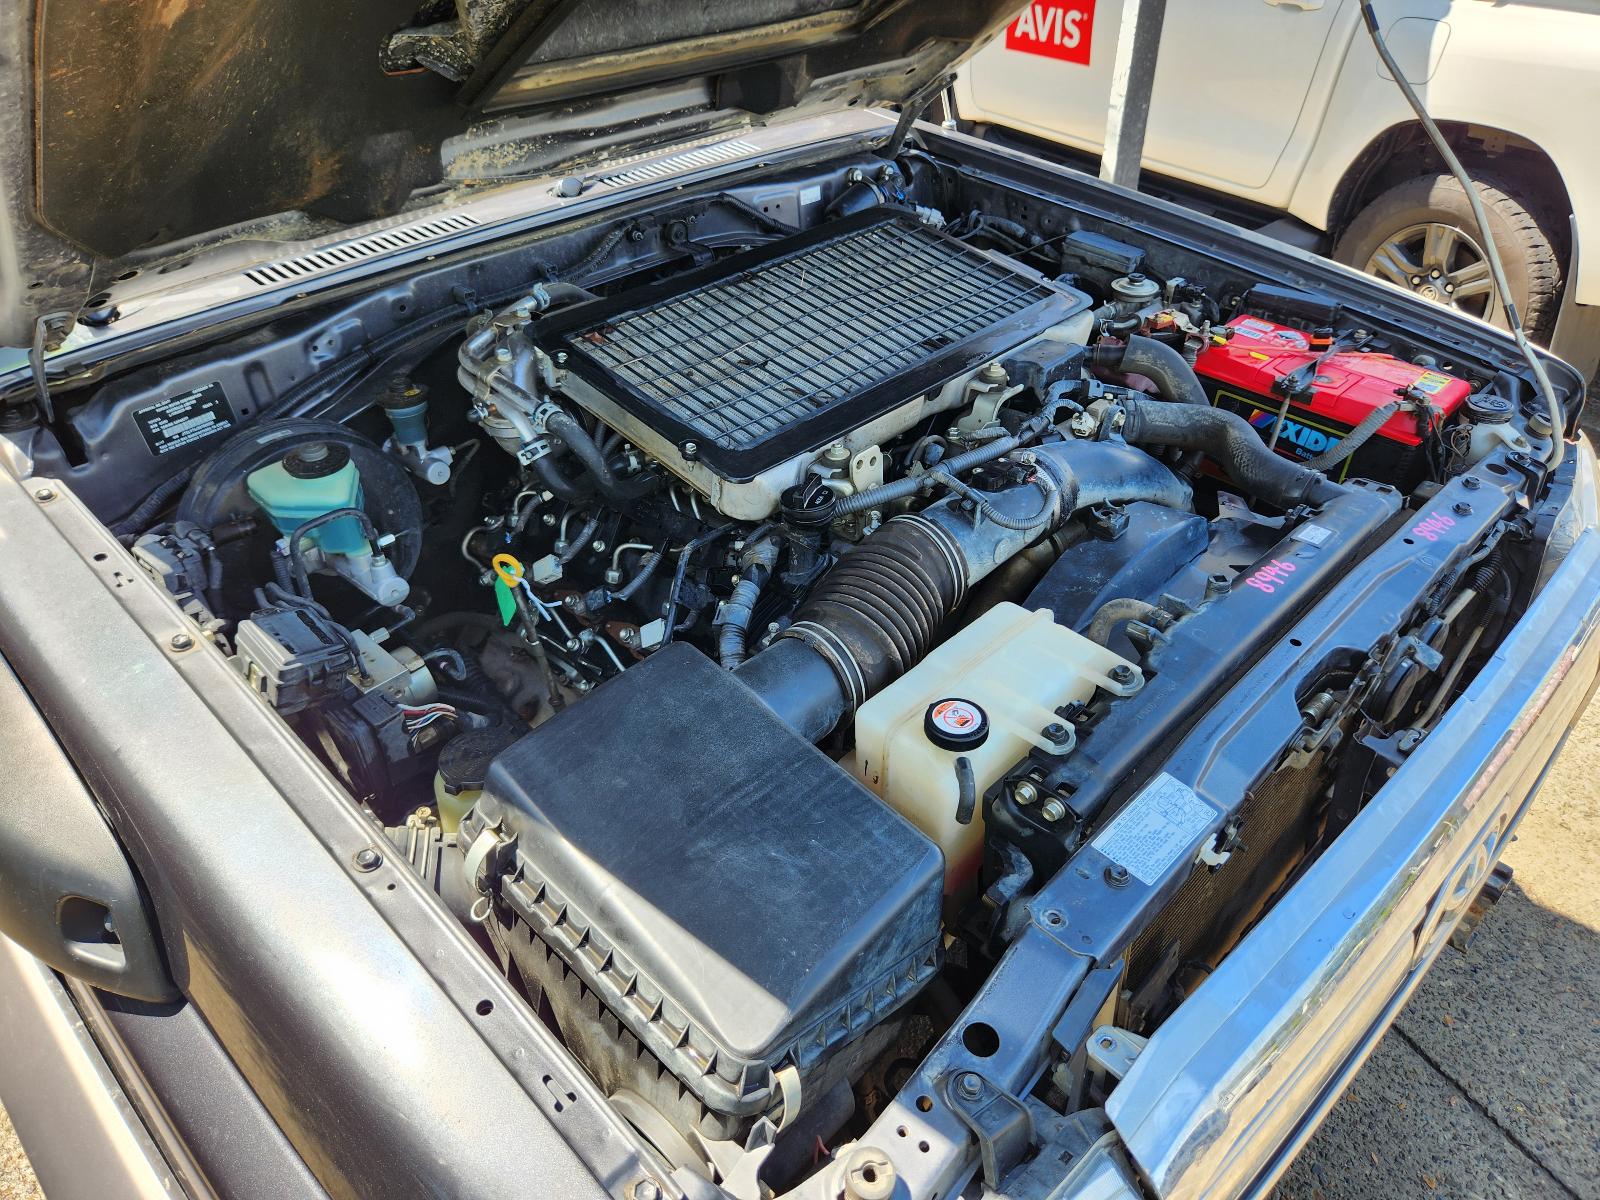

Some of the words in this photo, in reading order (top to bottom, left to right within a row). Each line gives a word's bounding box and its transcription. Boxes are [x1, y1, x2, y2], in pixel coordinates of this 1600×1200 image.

[1014, 4, 1082, 49] AVIS
[1412, 511, 1456, 541] 8946
[1245, 559, 1296, 593] 8946
